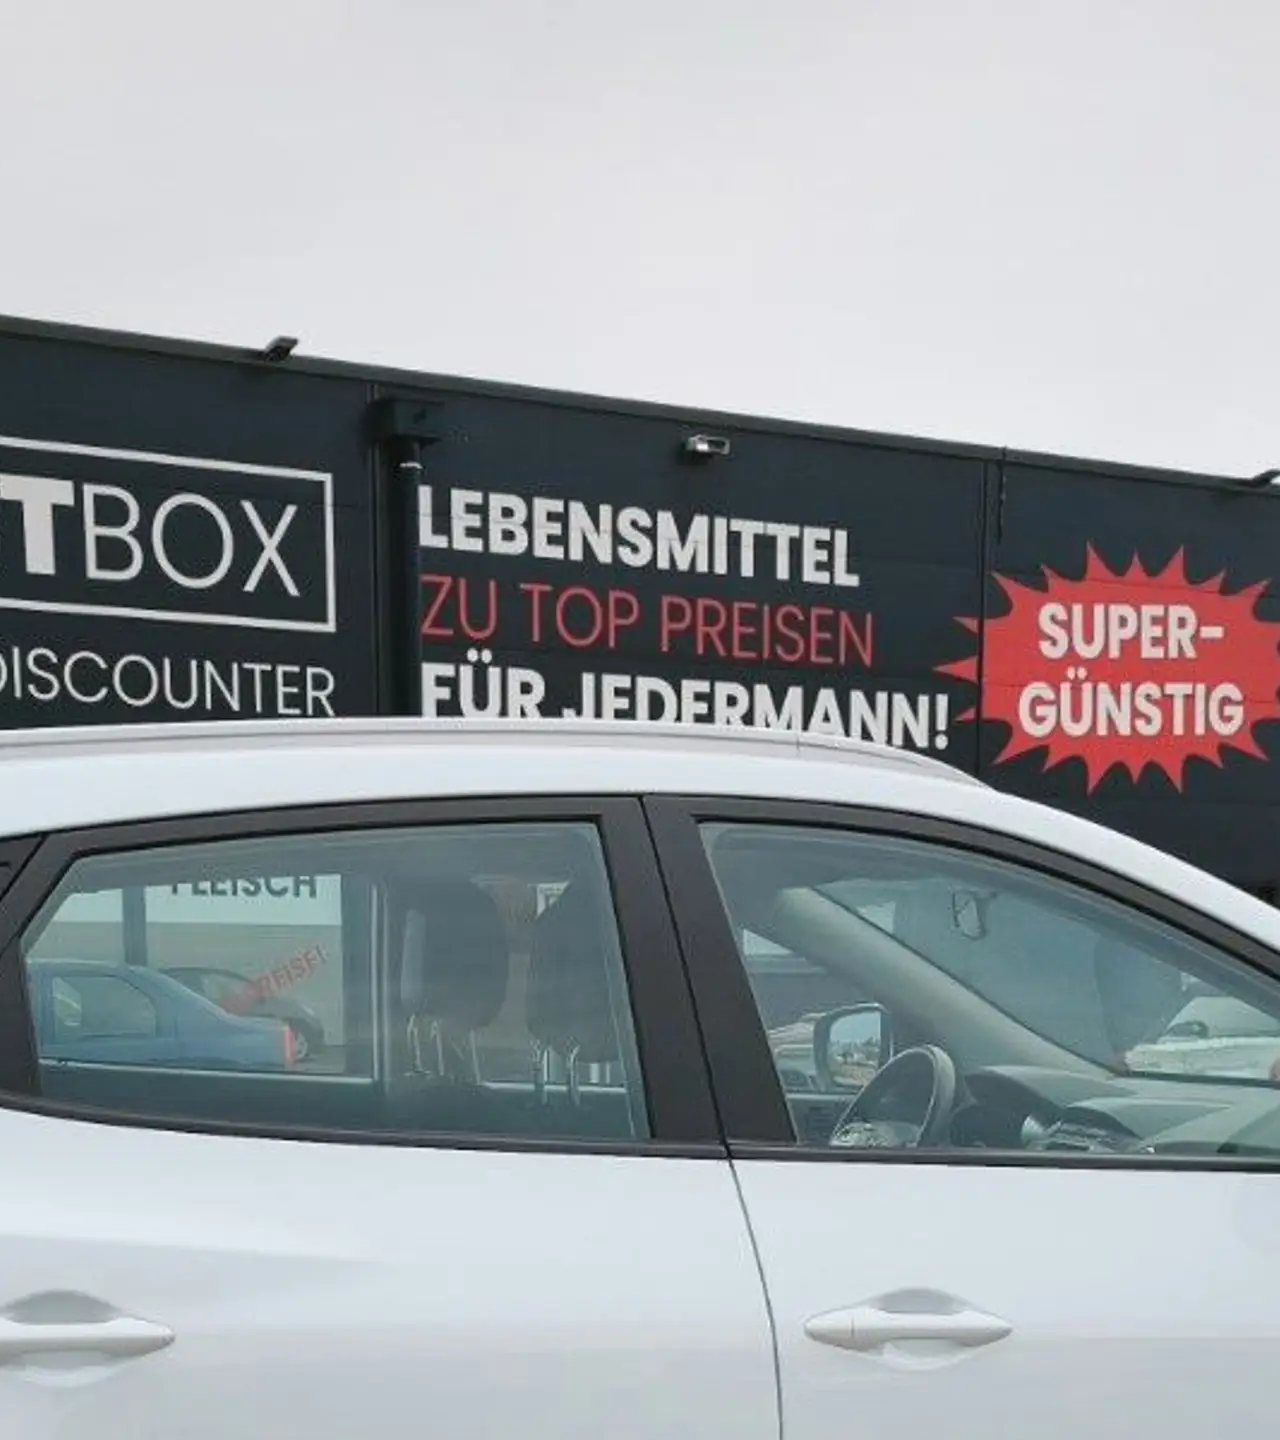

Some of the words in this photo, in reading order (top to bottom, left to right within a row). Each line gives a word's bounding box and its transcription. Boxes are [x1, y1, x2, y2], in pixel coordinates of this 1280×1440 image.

[418, 485, 860, 588] LEBENSMITTEL
[419, 574, 497, 641] ZU
[519, 583, 639, 651] TOP
[659, 600, 874, 669] PREISEN
[1038, 602, 1225, 659] SUPER-
[419, 648, 547, 720] FÜR
[562, 671, 950, 751] JEDERMANN!
[1018, 666, 1245, 738] GÜNSTIG
